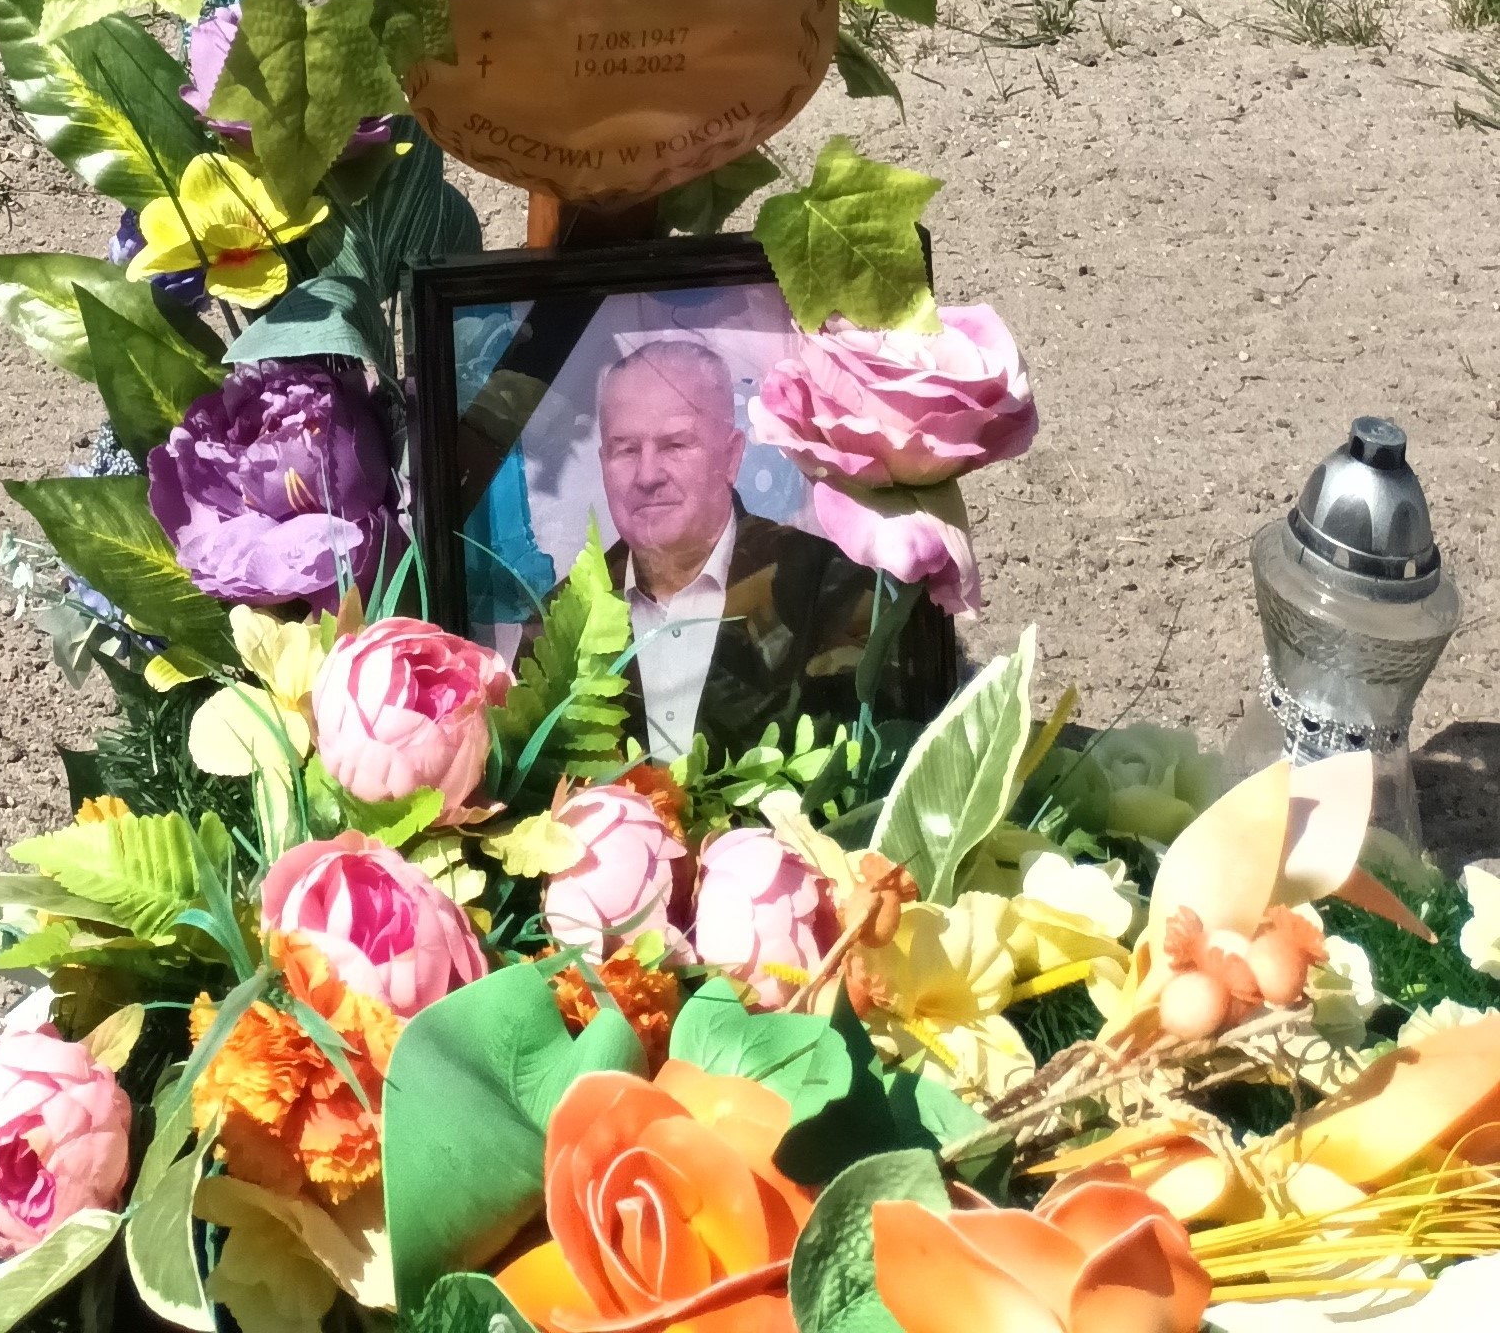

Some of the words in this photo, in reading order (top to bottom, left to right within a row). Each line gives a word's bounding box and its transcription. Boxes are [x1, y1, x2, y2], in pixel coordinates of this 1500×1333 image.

[575, 27, 690, 52] 17.08.1947
[574, 53, 687, 78] 19.04.2022
[463, 112, 604, 171] SPOCZYWAJ
[618, 145, 642, 166] W
[654, 101, 752, 160] POKOJU
